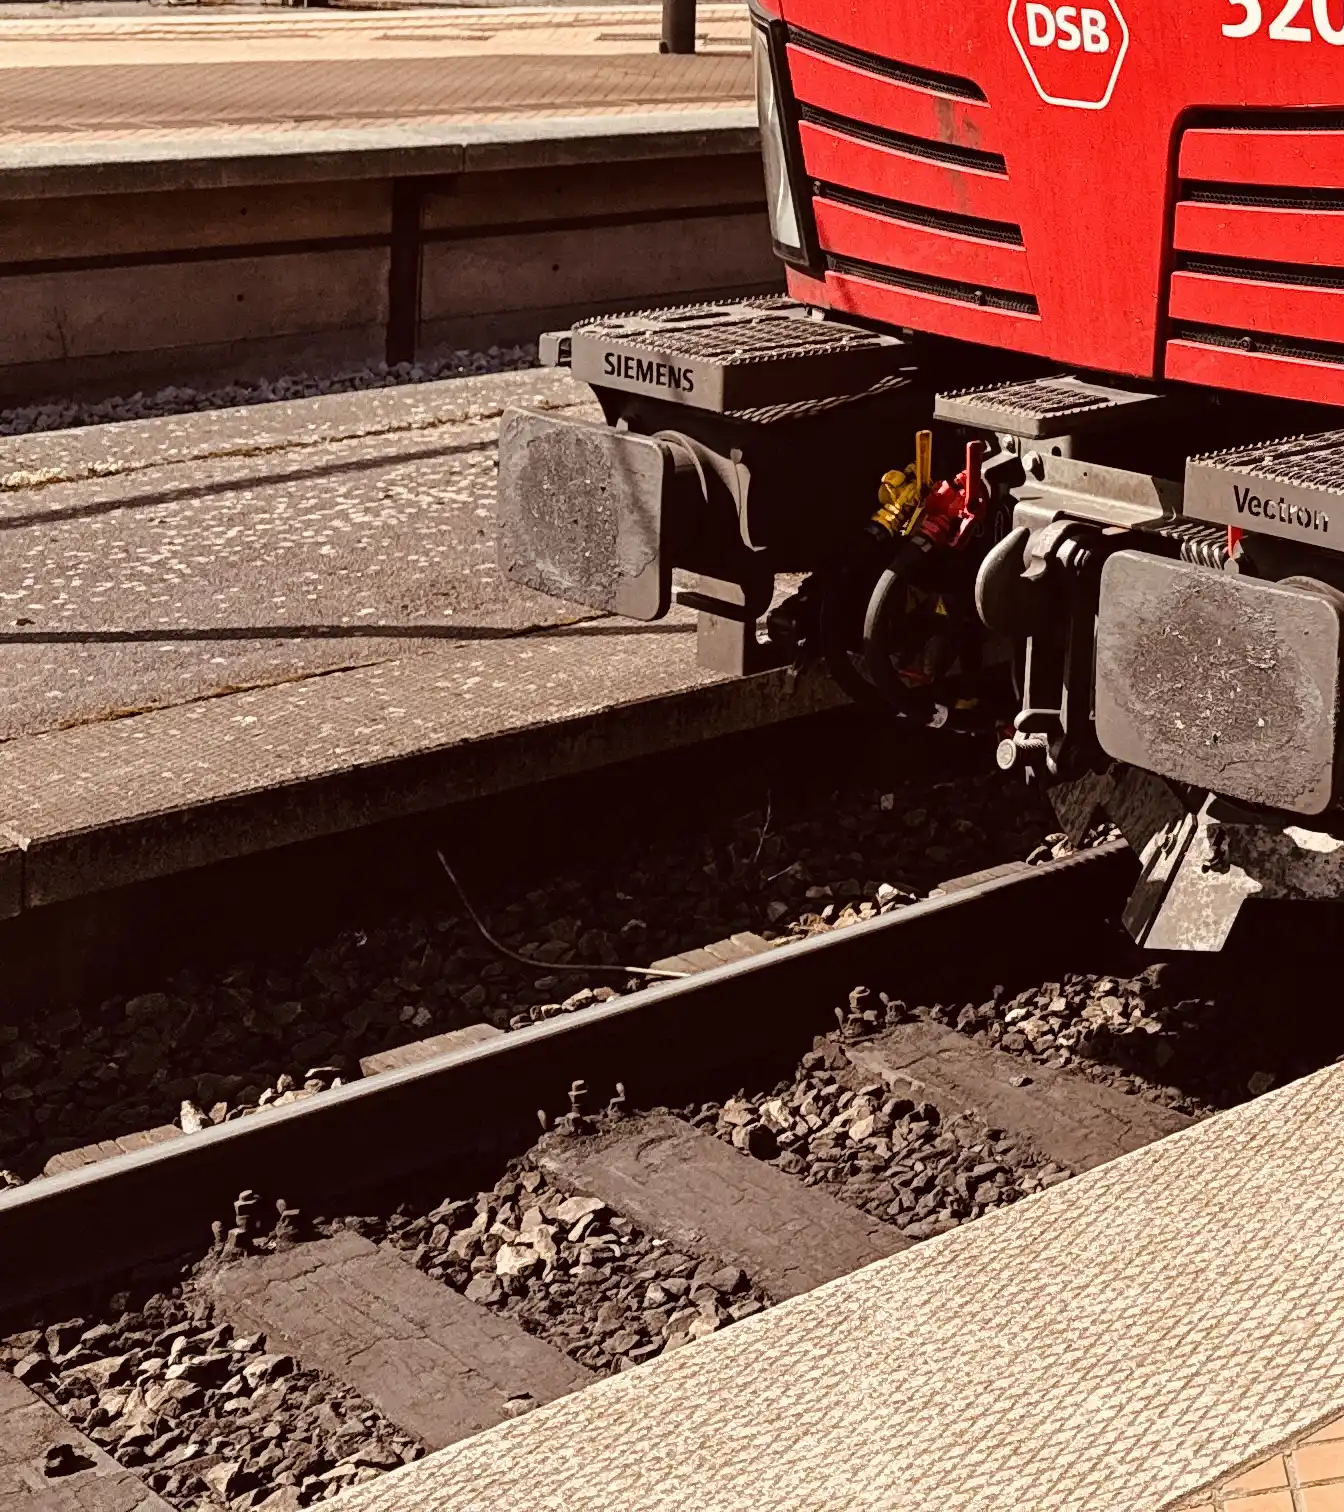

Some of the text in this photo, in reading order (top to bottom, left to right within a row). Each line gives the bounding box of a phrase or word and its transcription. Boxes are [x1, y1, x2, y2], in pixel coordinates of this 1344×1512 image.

[1025, 3, 1109, 53] DSB
[604, 352, 694, 393] SIEMENS
[1233, 485, 1328, 533] Vectron
